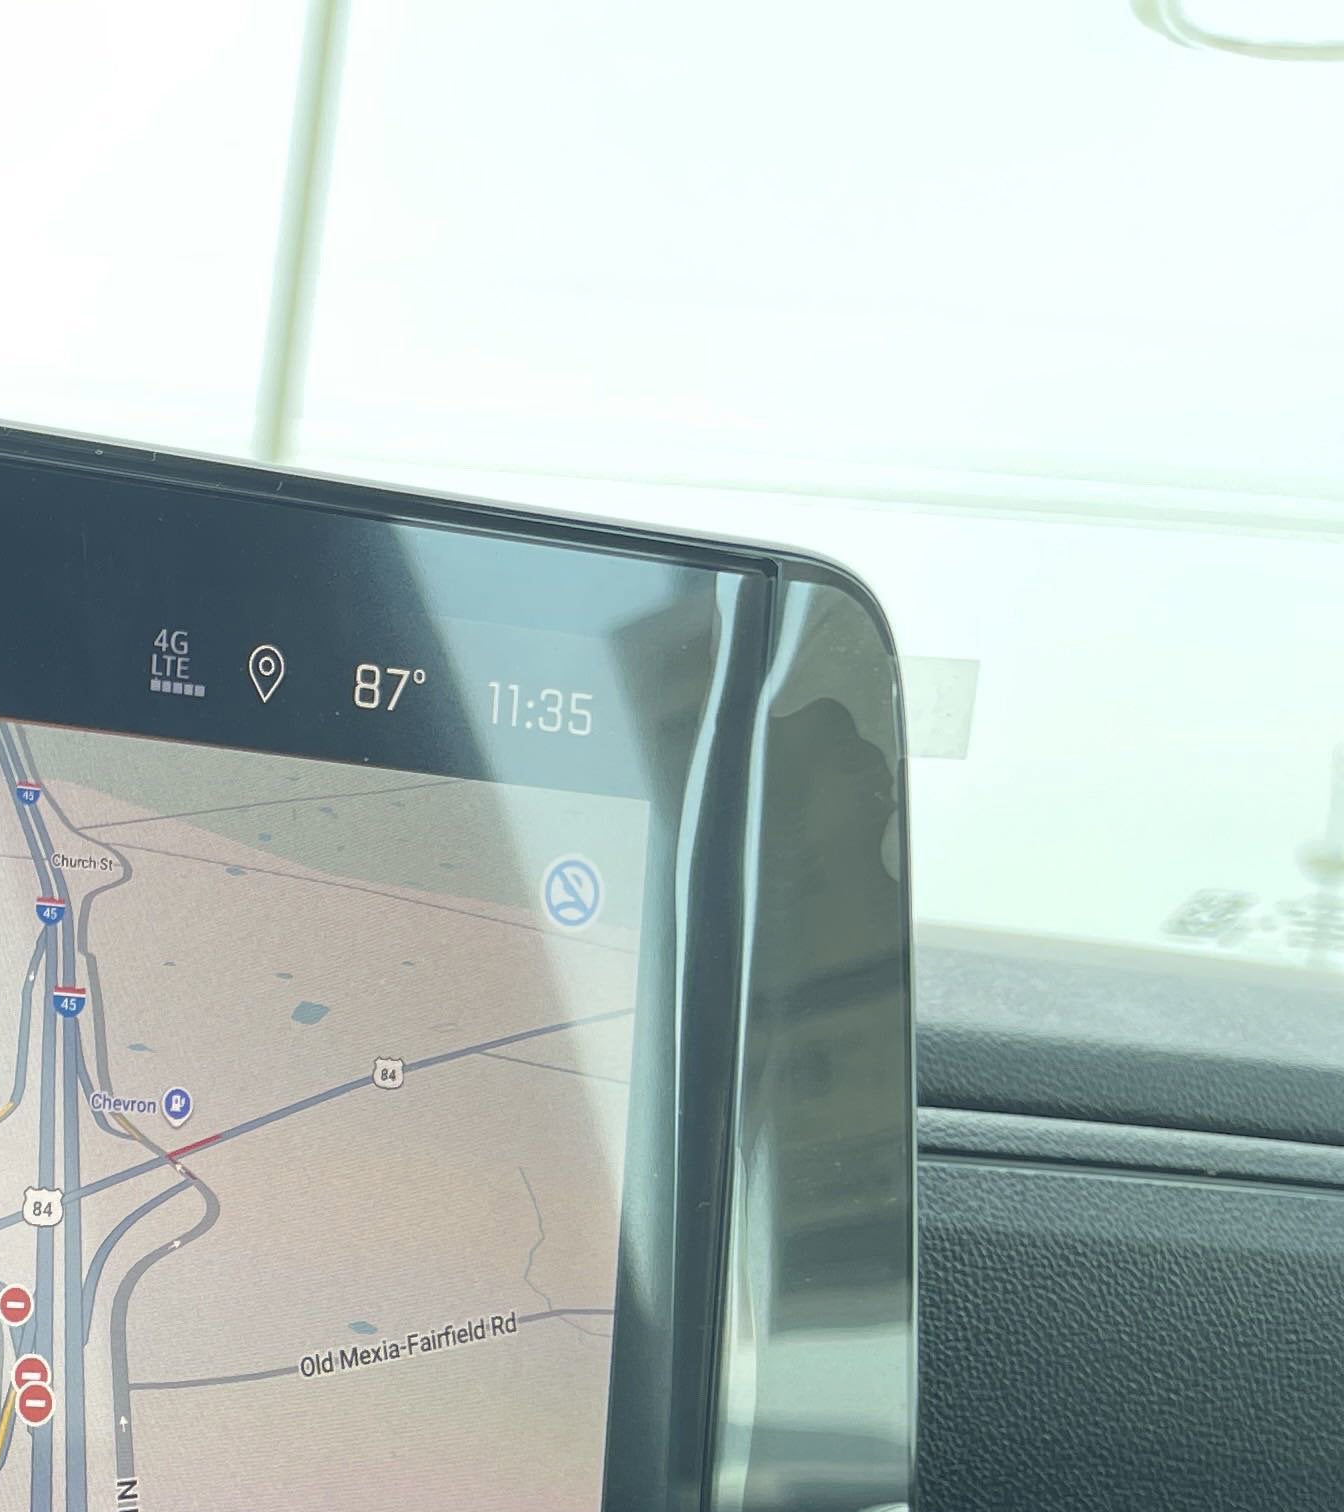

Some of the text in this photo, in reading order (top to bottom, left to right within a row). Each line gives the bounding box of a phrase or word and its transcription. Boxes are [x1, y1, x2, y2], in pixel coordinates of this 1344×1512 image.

[153, 629, 189, 655] 4G
[151, 654, 191, 680] LTE
[354, 663, 426, 712] 87°
[488, 681, 594, 736] 11:35
[22, 790, 35, 801] 45
[51, 853, 114, 872] Church St
[42, 907, 58, 920] 45
[60, 997, 77, 1011] 45
[380, 1067, 397, 1082] 84
[90, 1093, 158, 1115] Chevron
[31, 1200, 54, 1218] 84
[300, 1311, 518, 1378] Old Mexia-Fairfield Rd
[116, 1479, 139, 1500] N
